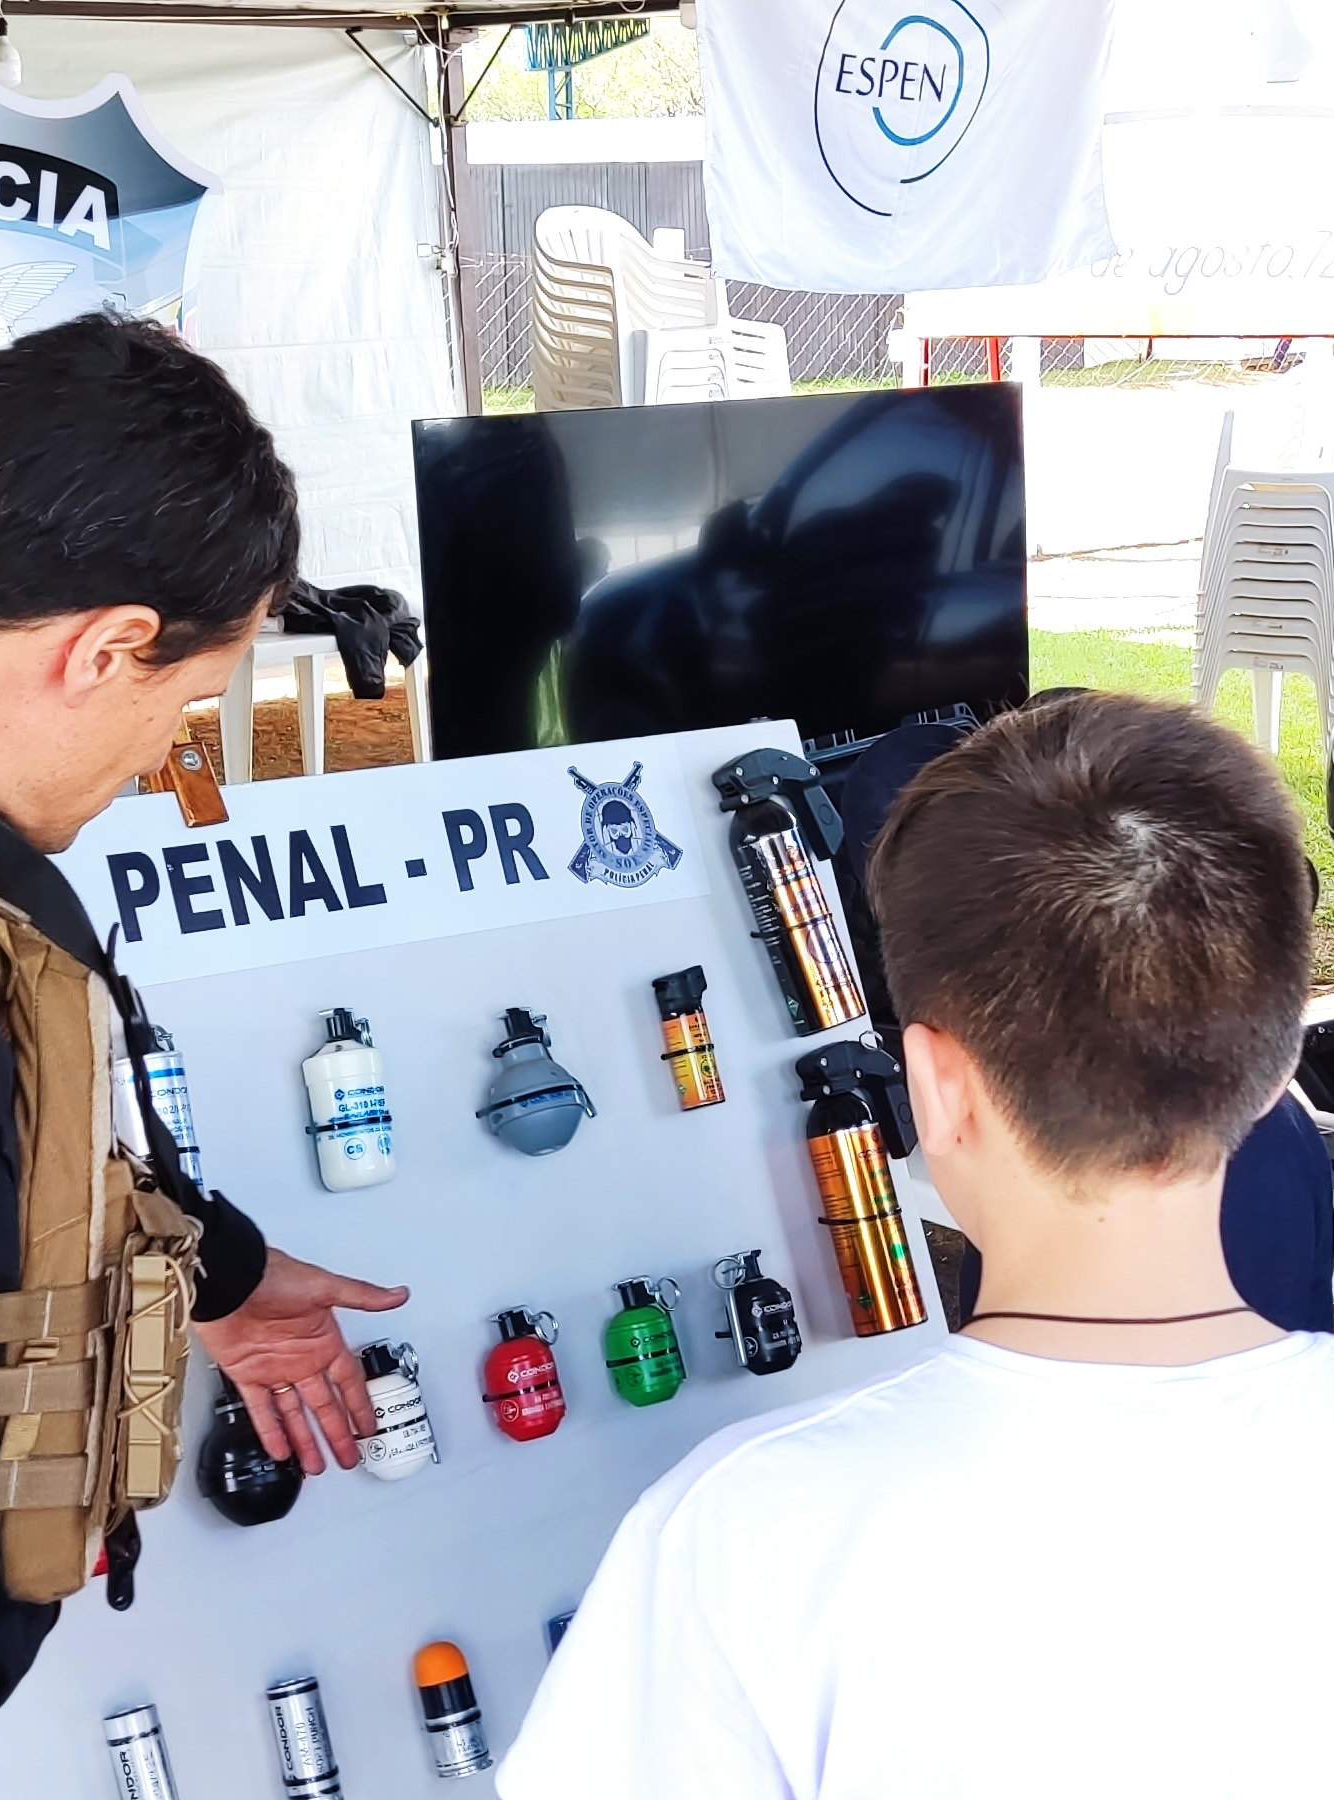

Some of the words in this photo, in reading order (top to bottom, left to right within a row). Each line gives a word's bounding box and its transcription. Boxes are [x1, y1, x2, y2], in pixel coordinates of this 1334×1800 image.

[835, 53, 947, 103] ESPEN
[105, 824, 388, 943] PENAL
[405, 858, 428, 878] -
[441, 802, 551, 892] PR
[275, 1706, 293, 1771] CONDOR
